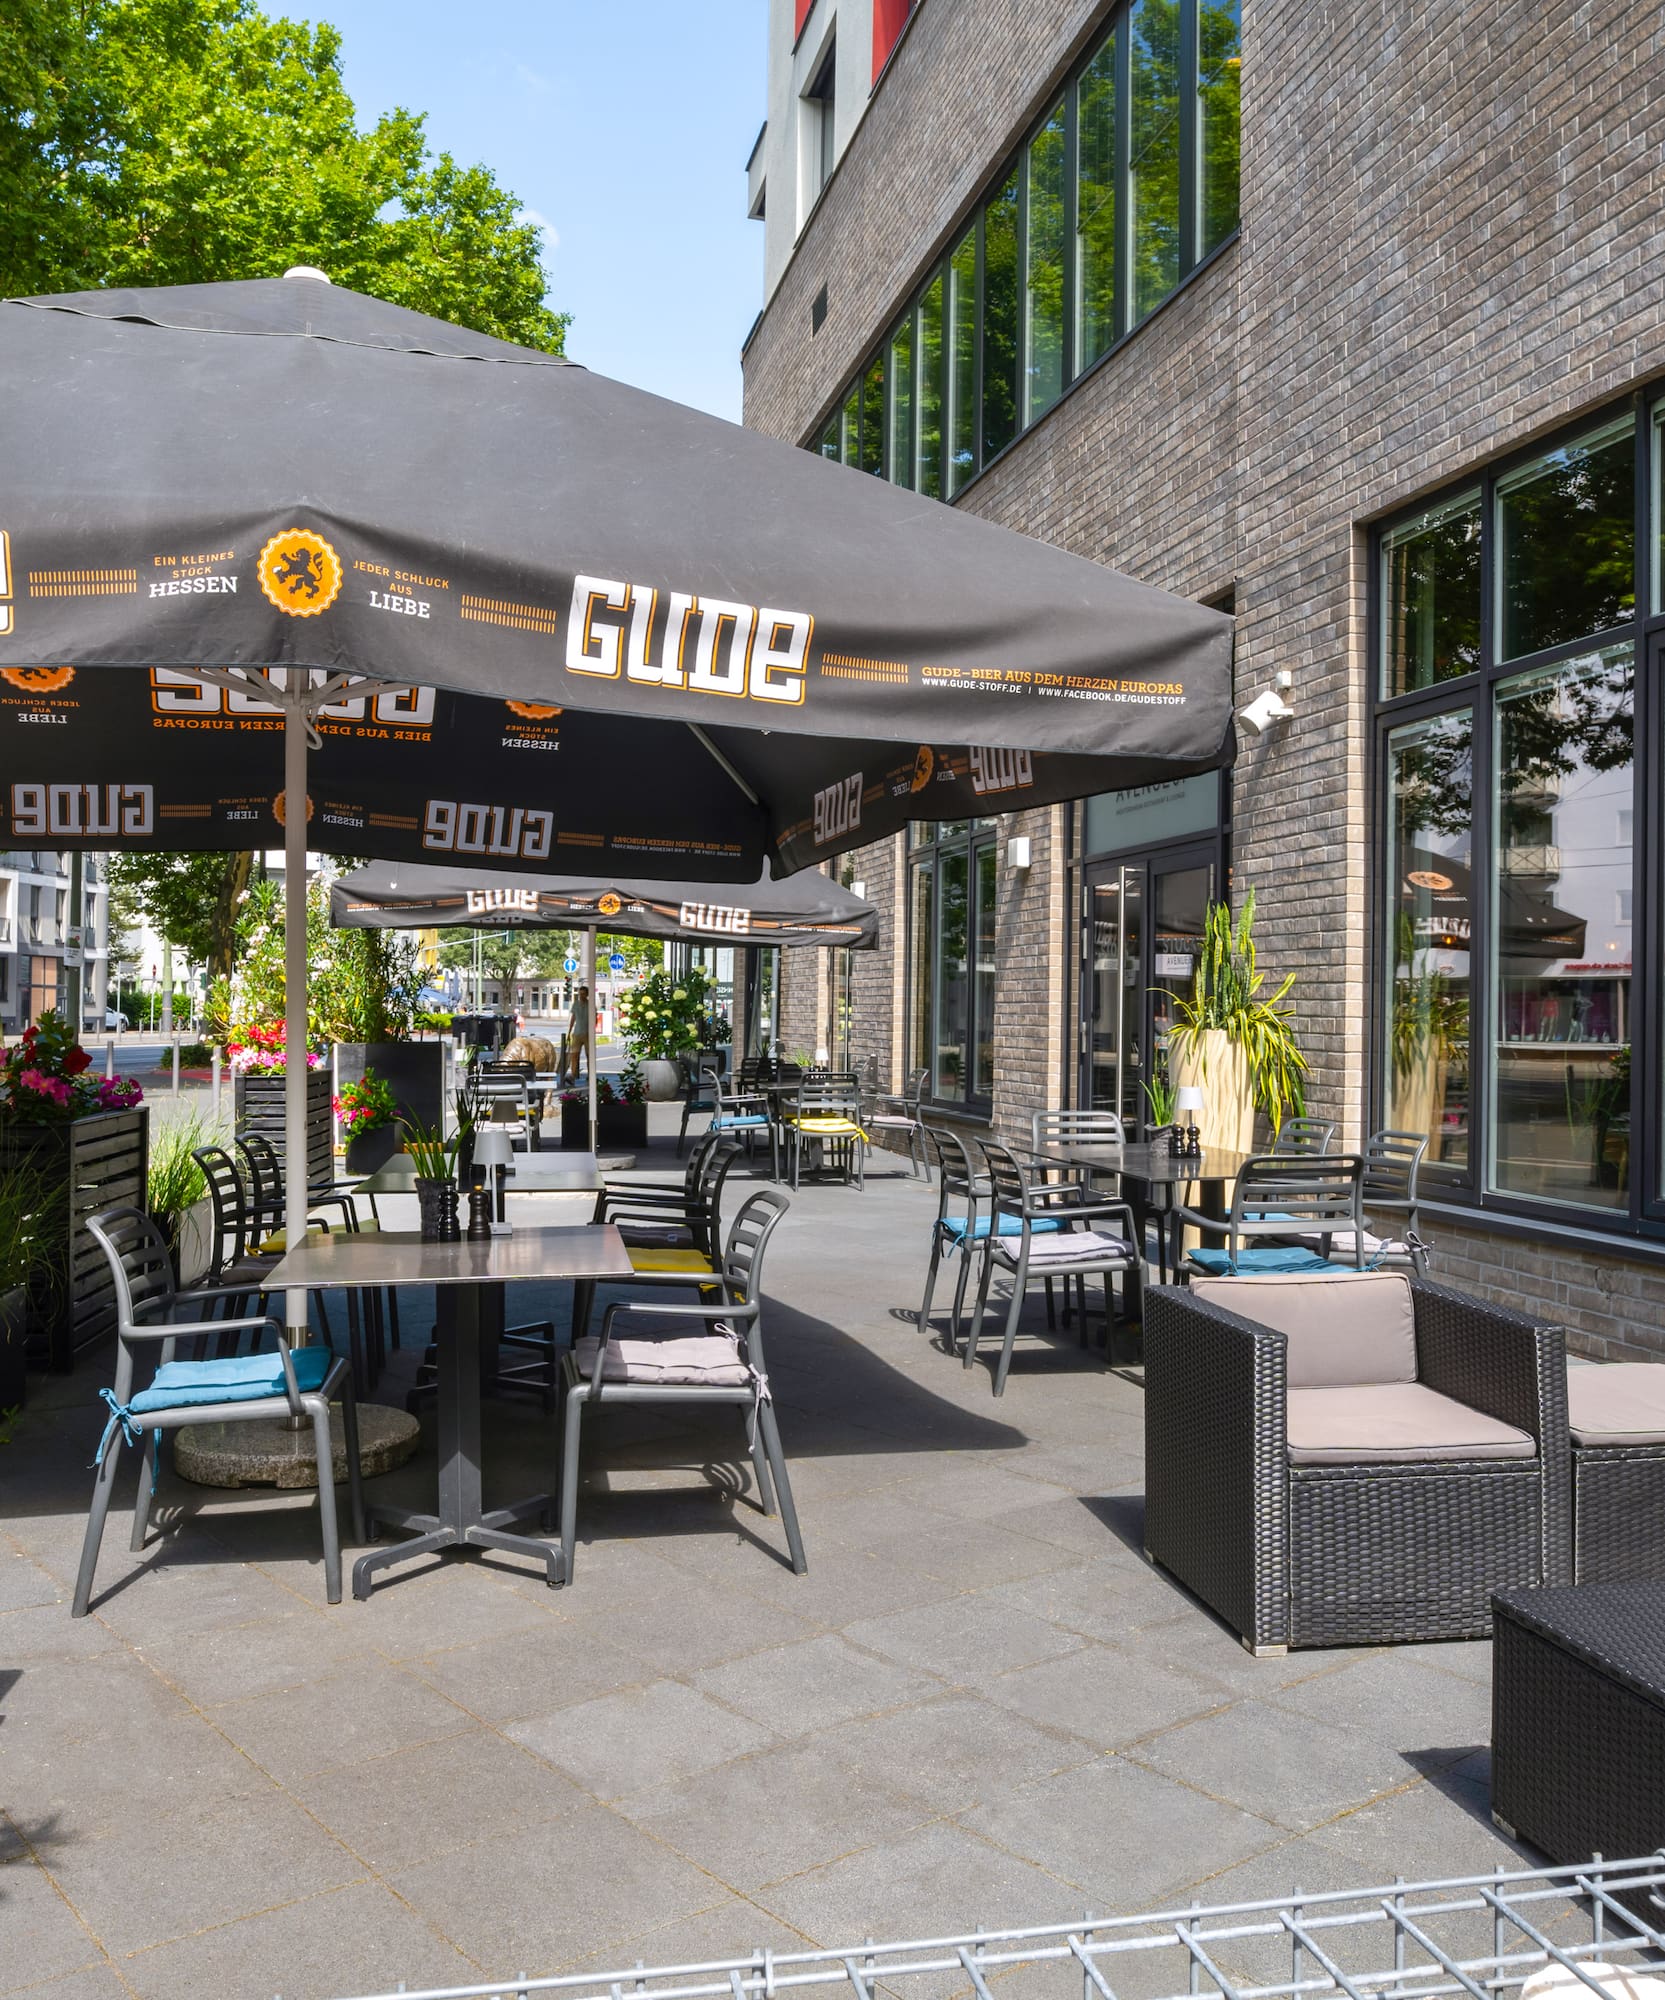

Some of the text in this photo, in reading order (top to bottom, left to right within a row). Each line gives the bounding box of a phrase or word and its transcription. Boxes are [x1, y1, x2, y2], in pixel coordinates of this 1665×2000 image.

[154, 551, 234, 567] EIN KLEINES
[172, 565, 212, 579] STÜCK
[352, 559, 449, 590] JEDER SCHLUCK
[148, 576, 237, 598] HESSEN
[389, 583, 412, 596] AUS
[369, 590, 431, 619] LIEBE
[921, 677, 1187, 705] WWW.GUDE-STOFF.DE WWW.FACEBOOK.DE/GUDESTOFF
[1004, 670, 1031, 684] AUS
[1034, 672, 1063, 687] DEM
[1066, 675, 1118, 691] HERZEN
[1120, 680, 1183, 695] EUROPAS
